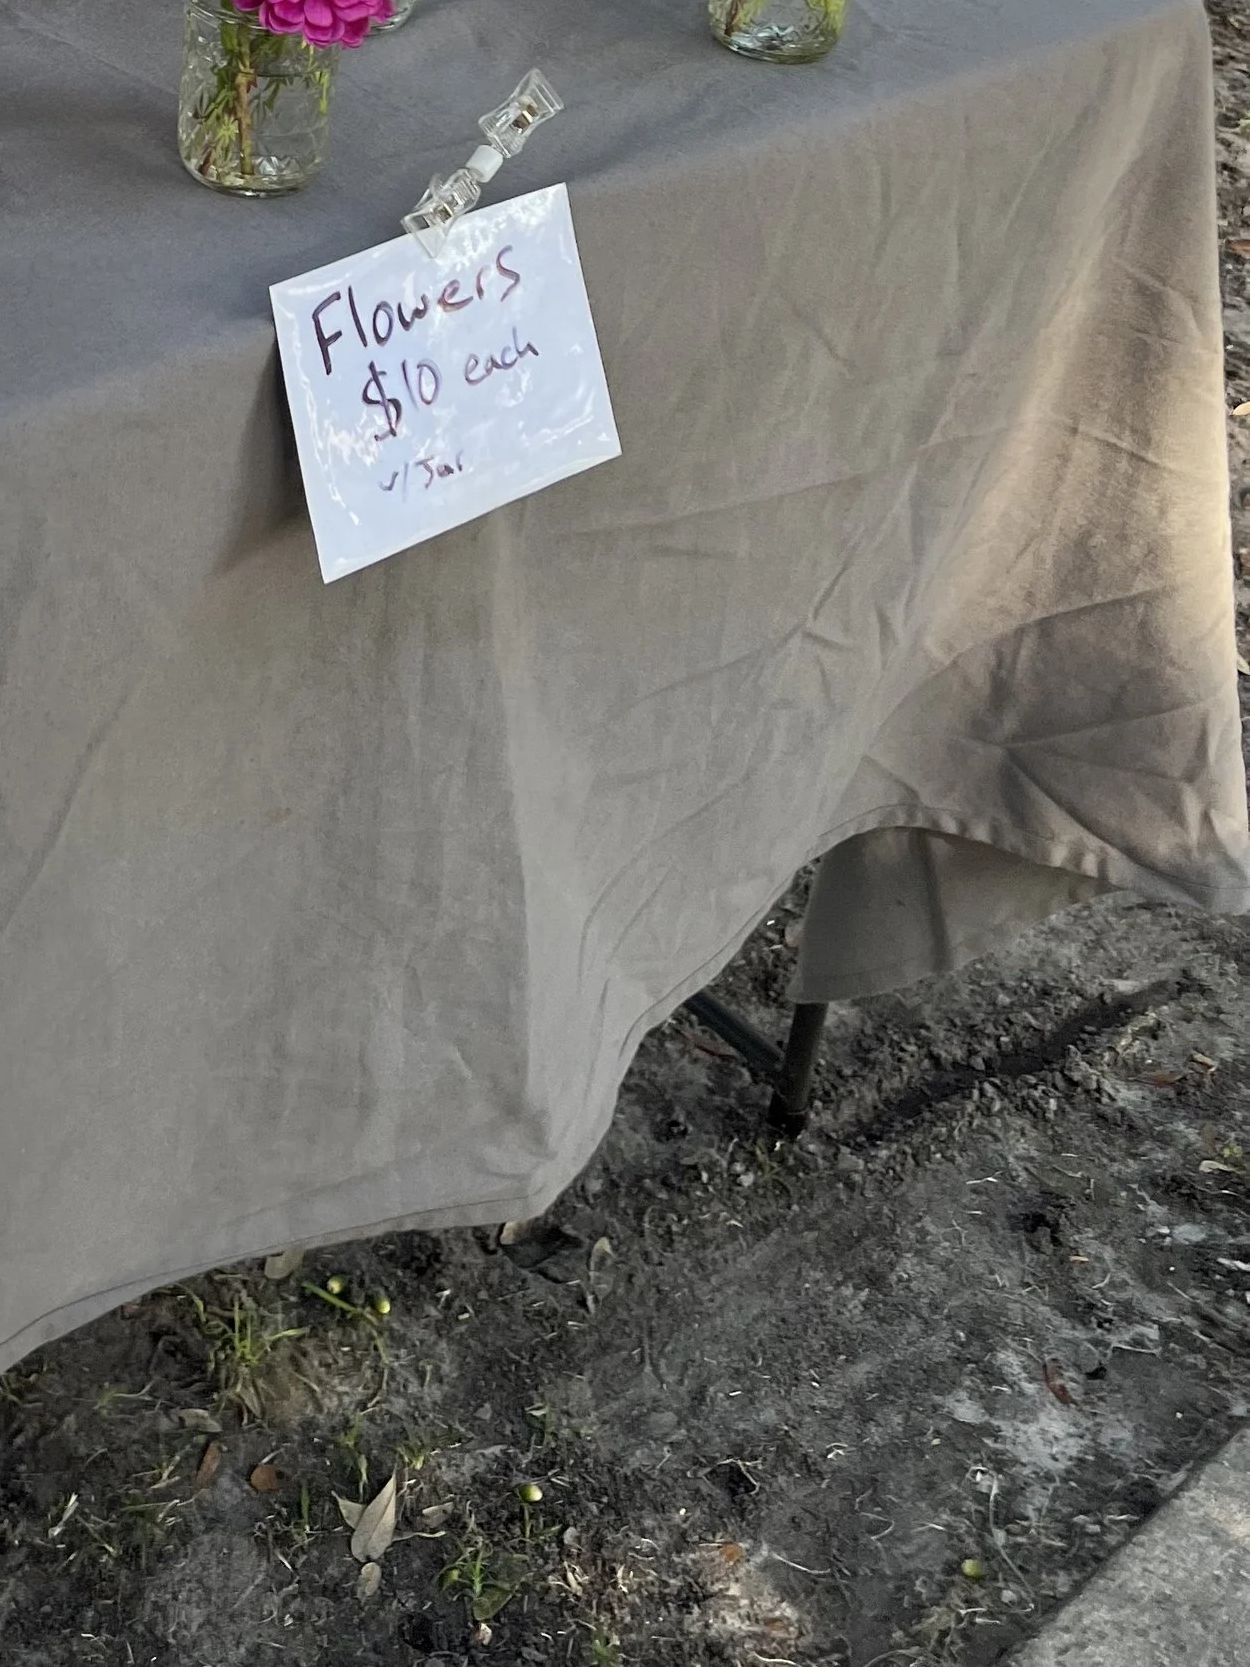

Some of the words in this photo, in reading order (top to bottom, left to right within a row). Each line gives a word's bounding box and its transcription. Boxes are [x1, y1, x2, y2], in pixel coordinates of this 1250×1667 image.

[311, 244, 522, 376] Flowers
[362, 357, 444, 442] $10
[463, 326, 540, 386] each
